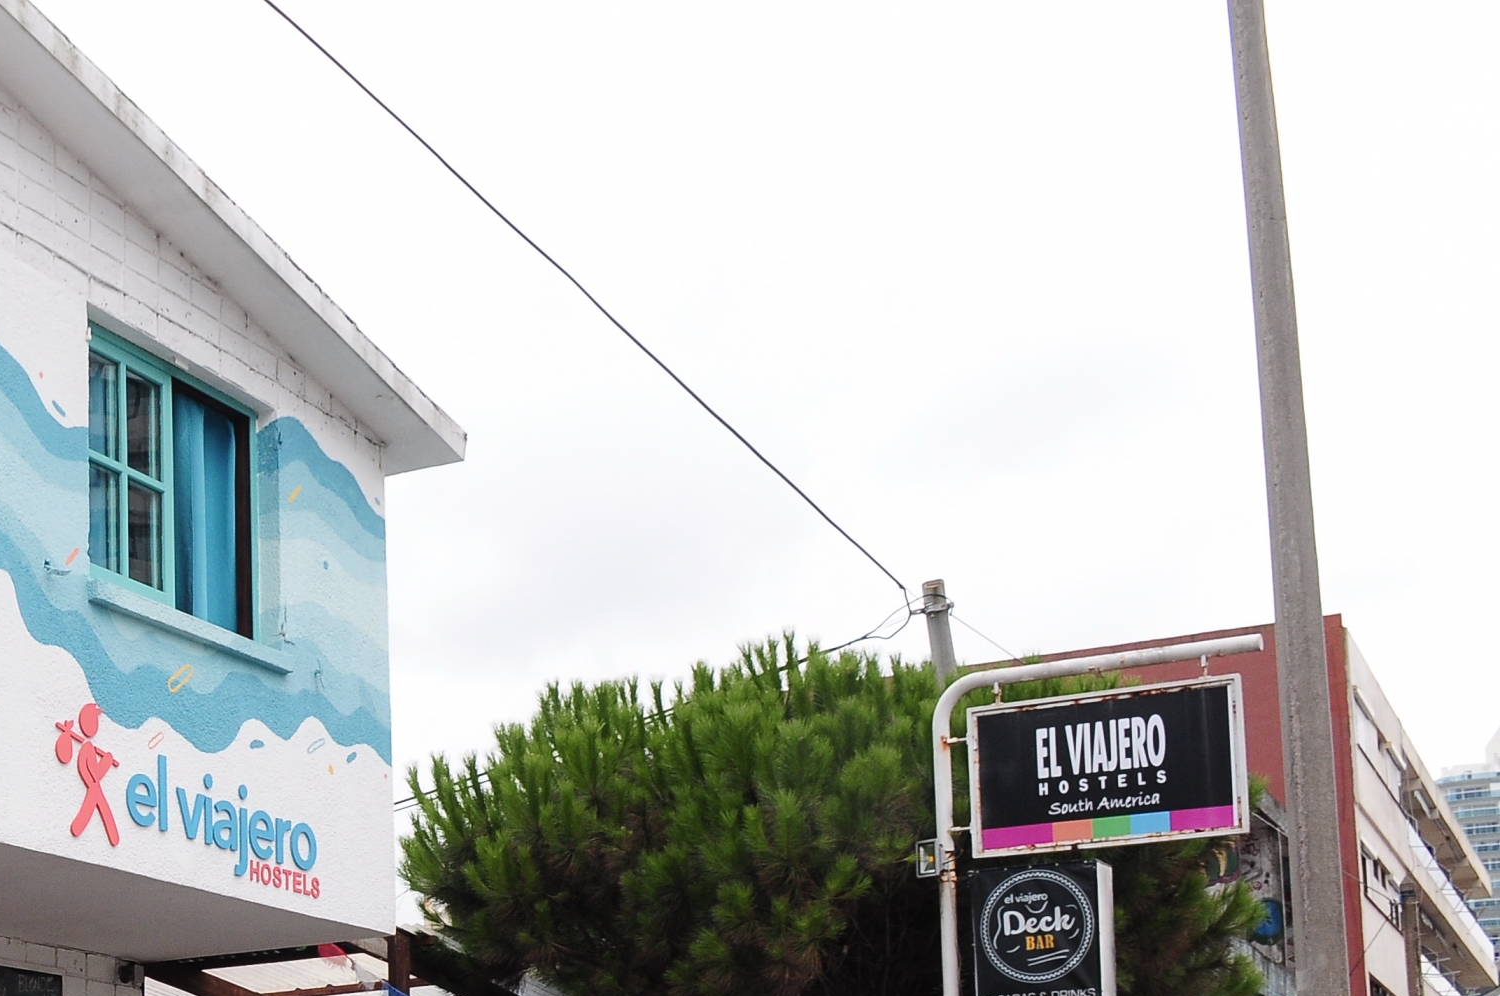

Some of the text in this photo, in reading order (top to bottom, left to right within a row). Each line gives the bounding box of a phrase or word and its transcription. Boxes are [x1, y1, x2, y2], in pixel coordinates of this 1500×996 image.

[1035, 713, 1167, 779] EL VIAJERO
[1038, 769, 1167, 796] HOSTELS
[125, 753, 317, 876] el viajero
[1047, 791, 1161, 815] South America
[250, 859, 321, 899] HOSTELS
[1003, 891, 1048, 904] el viajero
[1003, 906, 1075, 936] Deck
[1025, 933, 1055, 951] BAR
